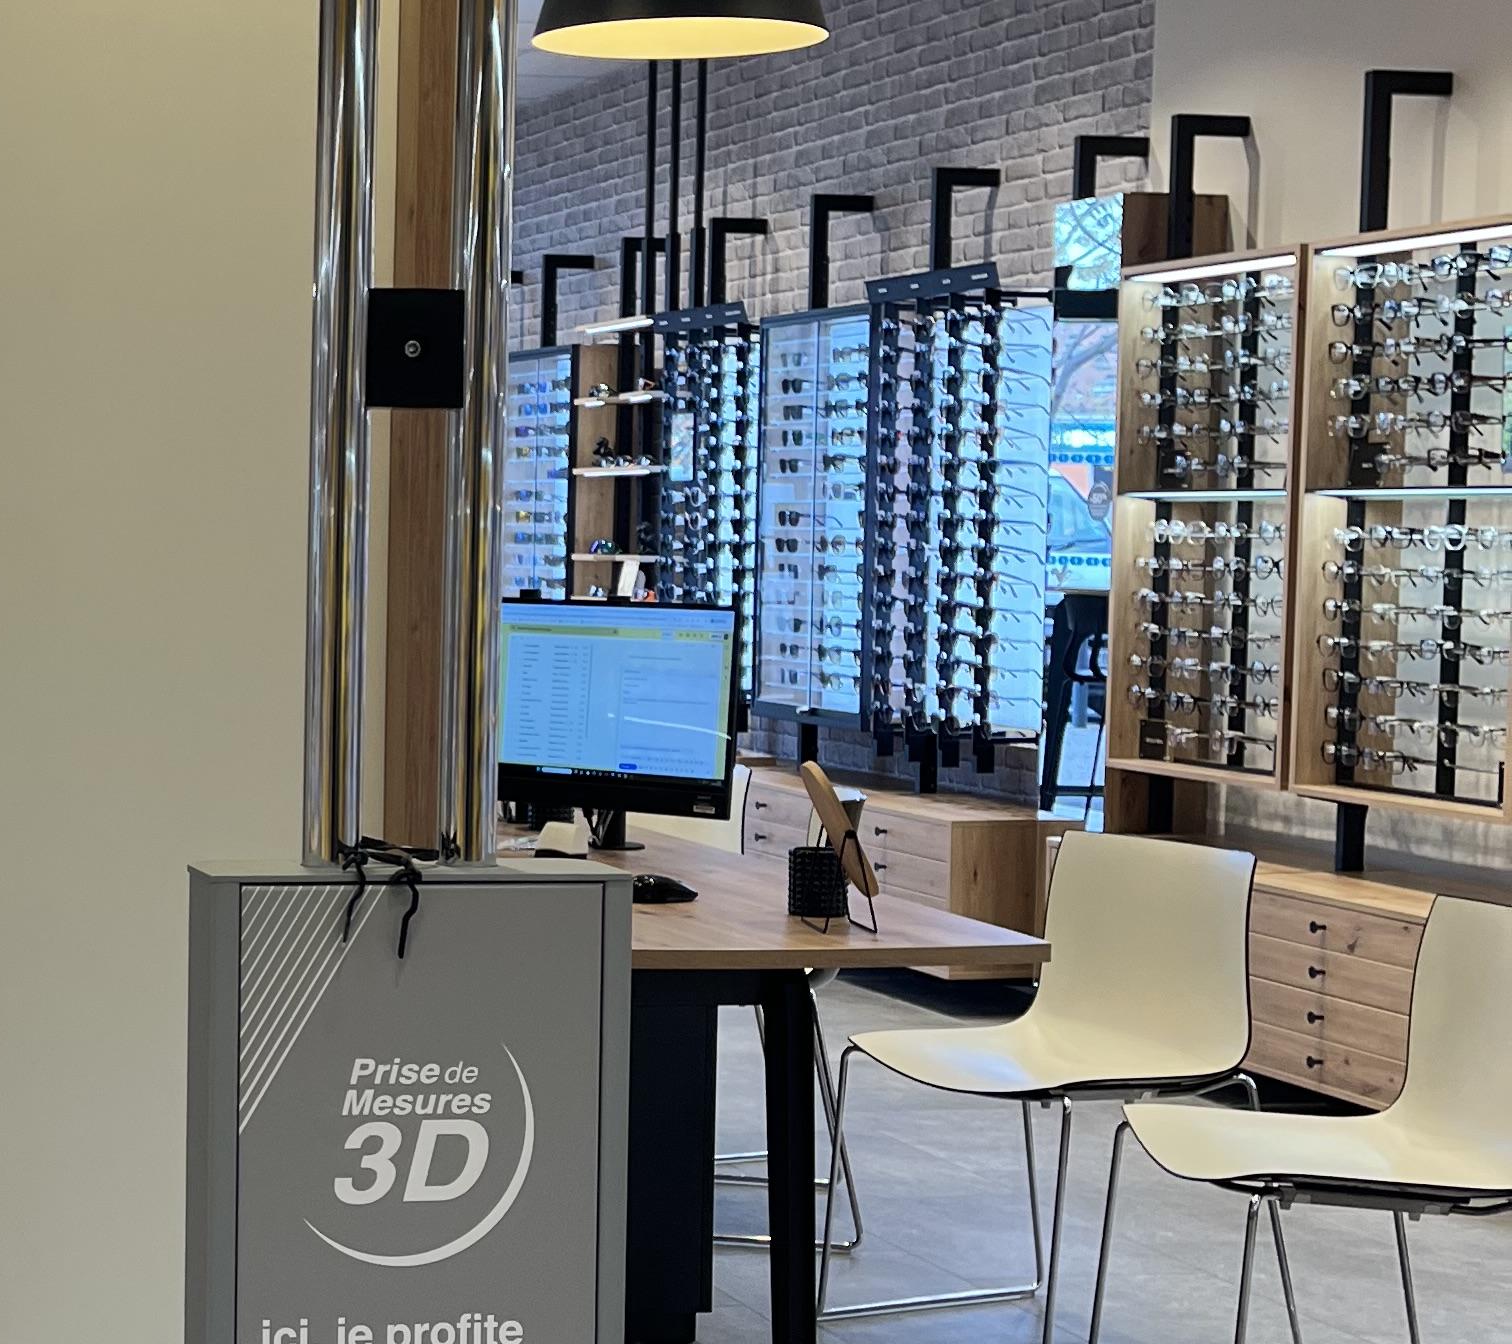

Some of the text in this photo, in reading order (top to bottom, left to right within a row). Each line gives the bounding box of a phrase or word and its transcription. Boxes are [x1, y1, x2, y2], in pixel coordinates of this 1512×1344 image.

[350, 1058, 479, 1085] Prise de
[341, 1088, 492, 1116] Mesures
[333, 1118, 490, 1205] 3D
